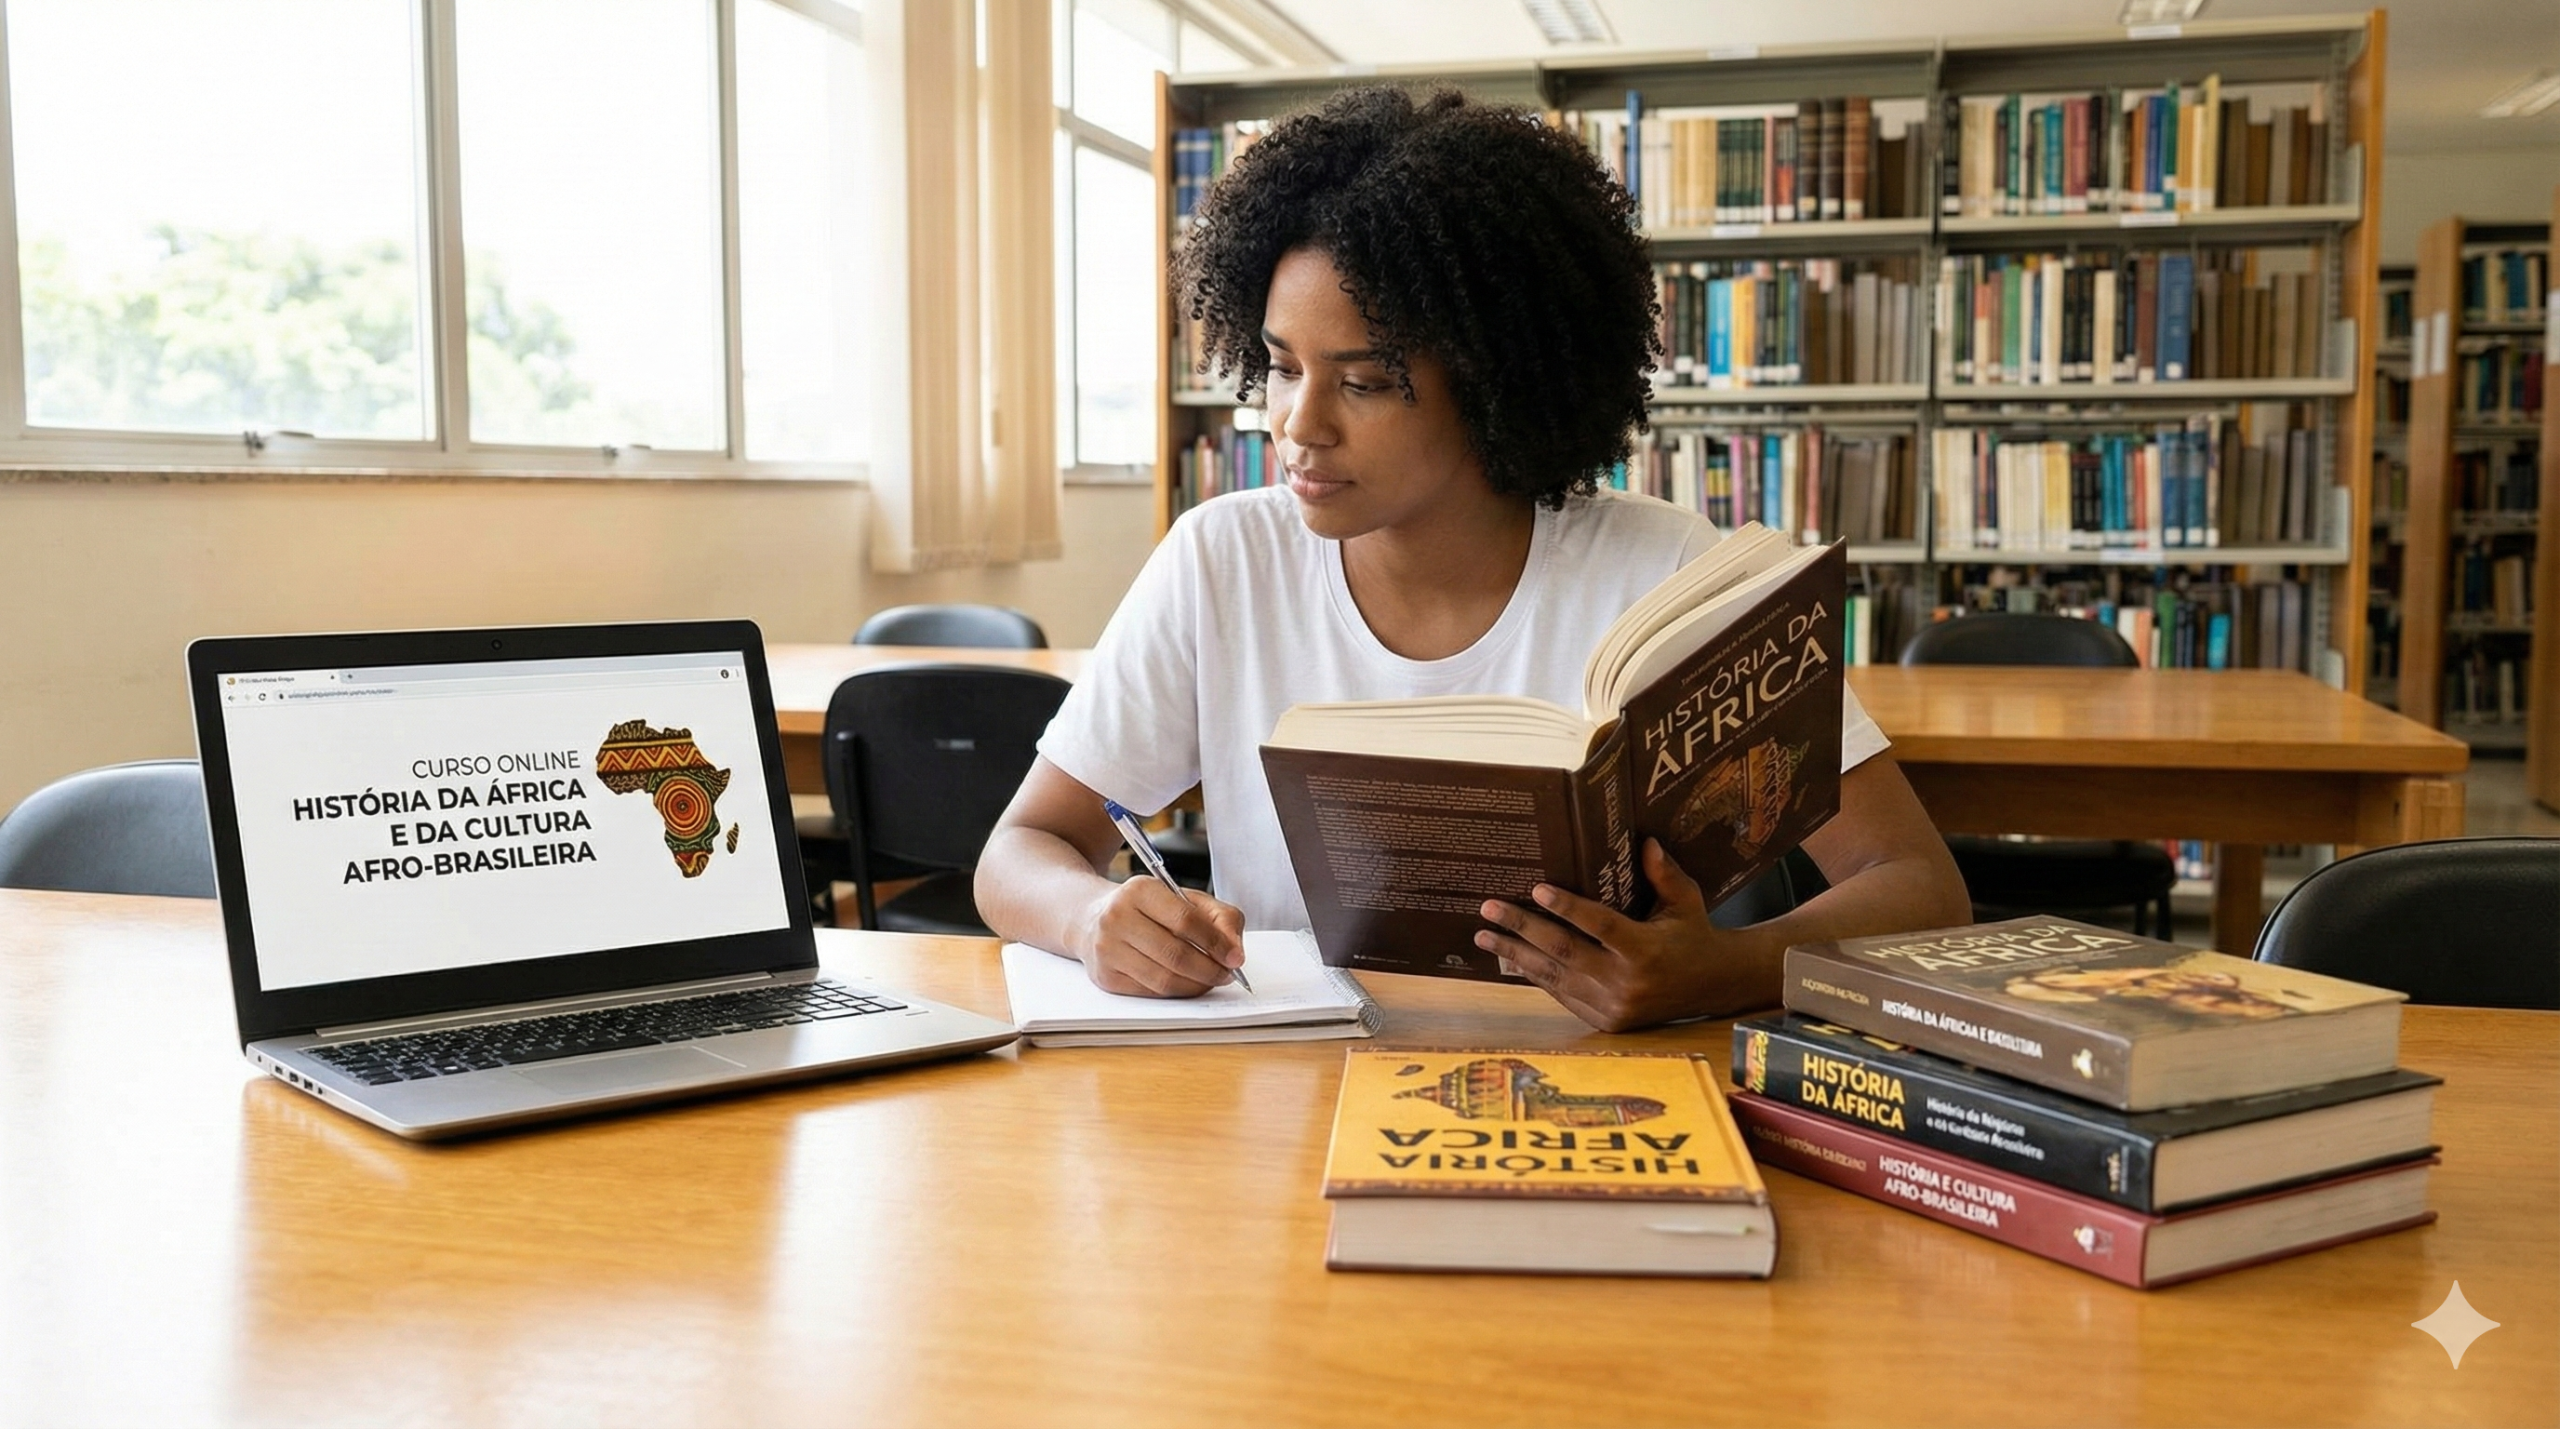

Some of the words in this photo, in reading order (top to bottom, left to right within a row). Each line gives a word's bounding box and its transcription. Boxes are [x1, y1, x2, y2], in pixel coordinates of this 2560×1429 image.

[1645, 638, 1779, 750] HISTÓRIA
[1787, 601, 1827, 644] DA
[1646, 636, 1829, 796] ÁFRICA
[412, 756, 491, 778] CURSO
[497, 750, 581, 773] ONLINE
[293, 787, 431, 821] HISTÓRIA
[438, 786, 479, 810] DA
[487, 778, 587, 806] ÁFRICA
[390, 823, 408, 846] E
[416, 822, 458, 844] DA
[465, 810, 592, 839] CULTURA
[343, 841, 597, 884] AFRO-BRASILEIRA
[1864, 930, 2026, 958] HISTÓRIA
[2024, 924, 2083, 940] DA
[1803, 1052, 1905, 1104] HISTÓRIA
[1802, 1080, 1829, 1108] DA
[1832, 1086, 1905, 1131] ÁFRICA
[1379, 1128, 1692, 1157] ÁFRICA
[1379, 1152, 1701, 1178] HISTÓRIA
[1879, 1156, 1941, 1191] HISTÓRIA
[1942, 1170, 1953, 1193] E
[1953, 1173, 2016, 1213] CULTURA
[1884, 1177, 1999, 1229] AFRO-BRASILEIRA
